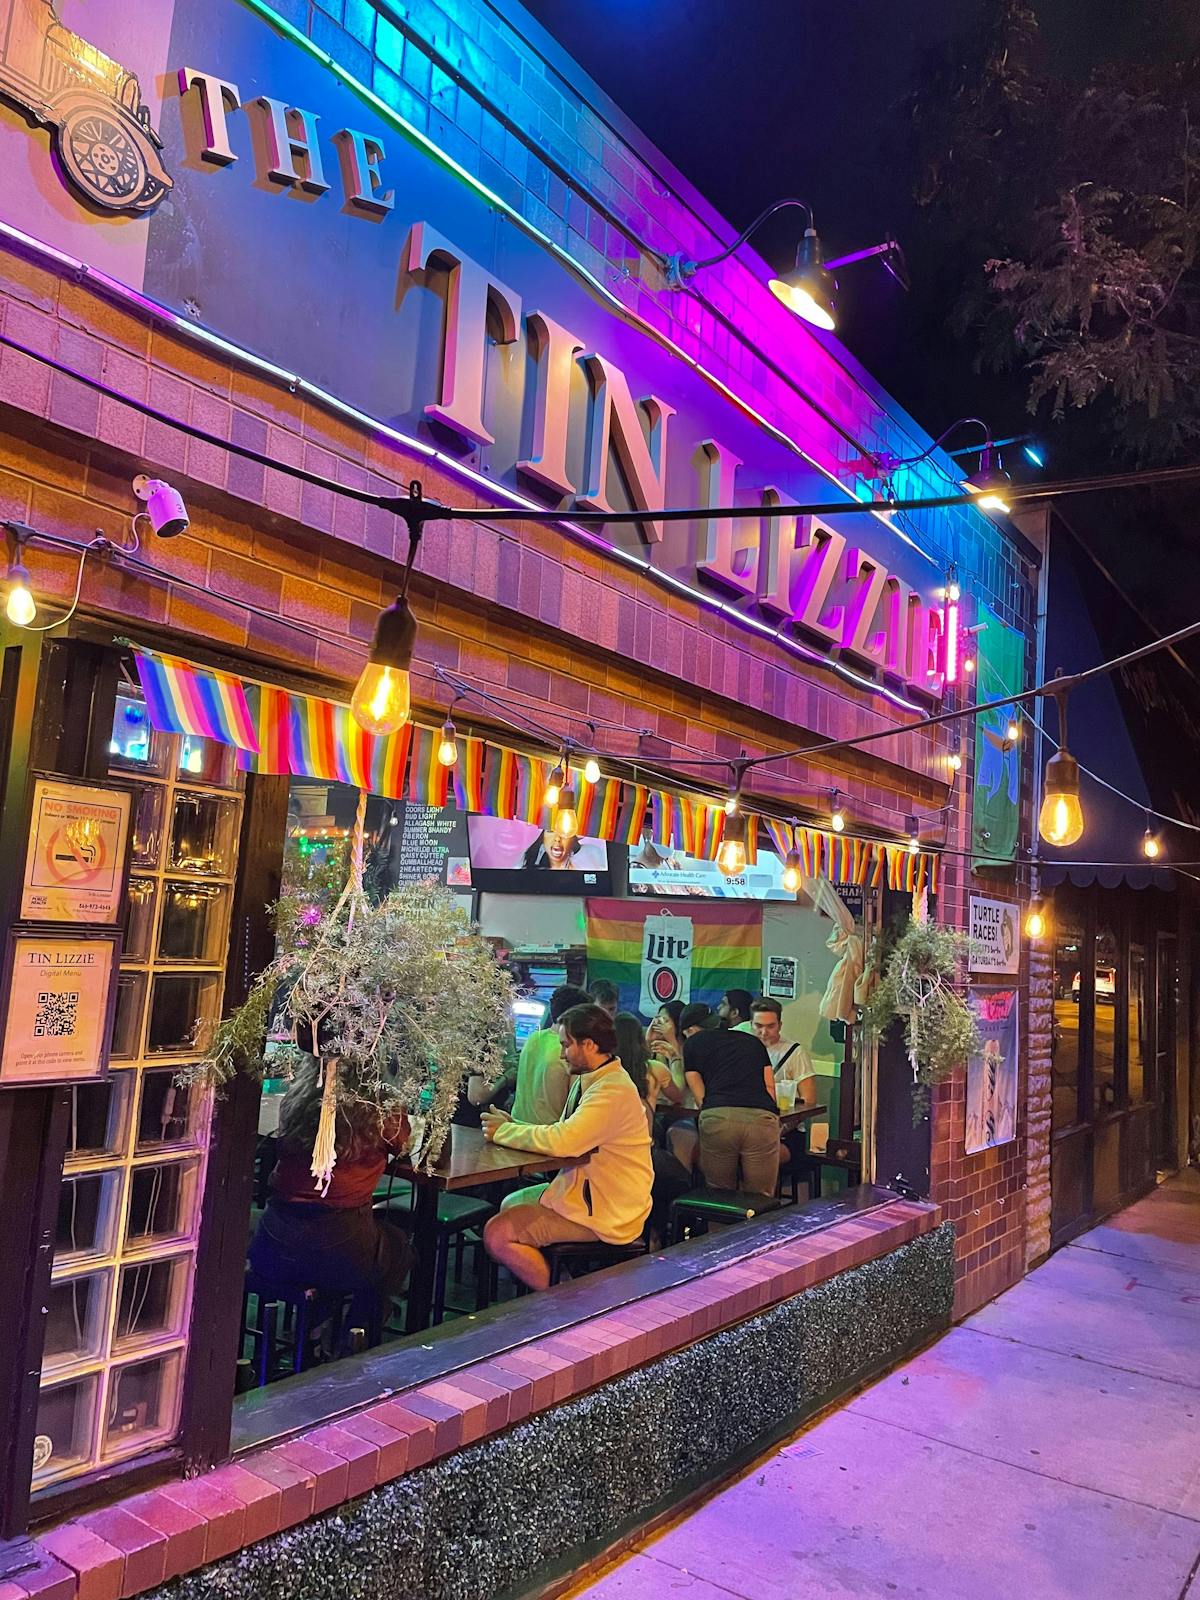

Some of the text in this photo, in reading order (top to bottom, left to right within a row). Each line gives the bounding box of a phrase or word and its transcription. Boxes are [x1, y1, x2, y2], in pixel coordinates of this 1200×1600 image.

[179, 67, 394, 210] THE
[409, 221, 945, 699] TIN LIZZIE
[44, 800, 117, 819] NO SMOKING
[726, 877, 745, 886] 9:58
[973, 905, 1000, 923] TURTLE
[973, 923, 998, 941] RACES!
[28, 952, 95, 964] TIN LIZZIE
[645, 933, 689, 965] Lite
[40, 969, 61, 977] Digital
